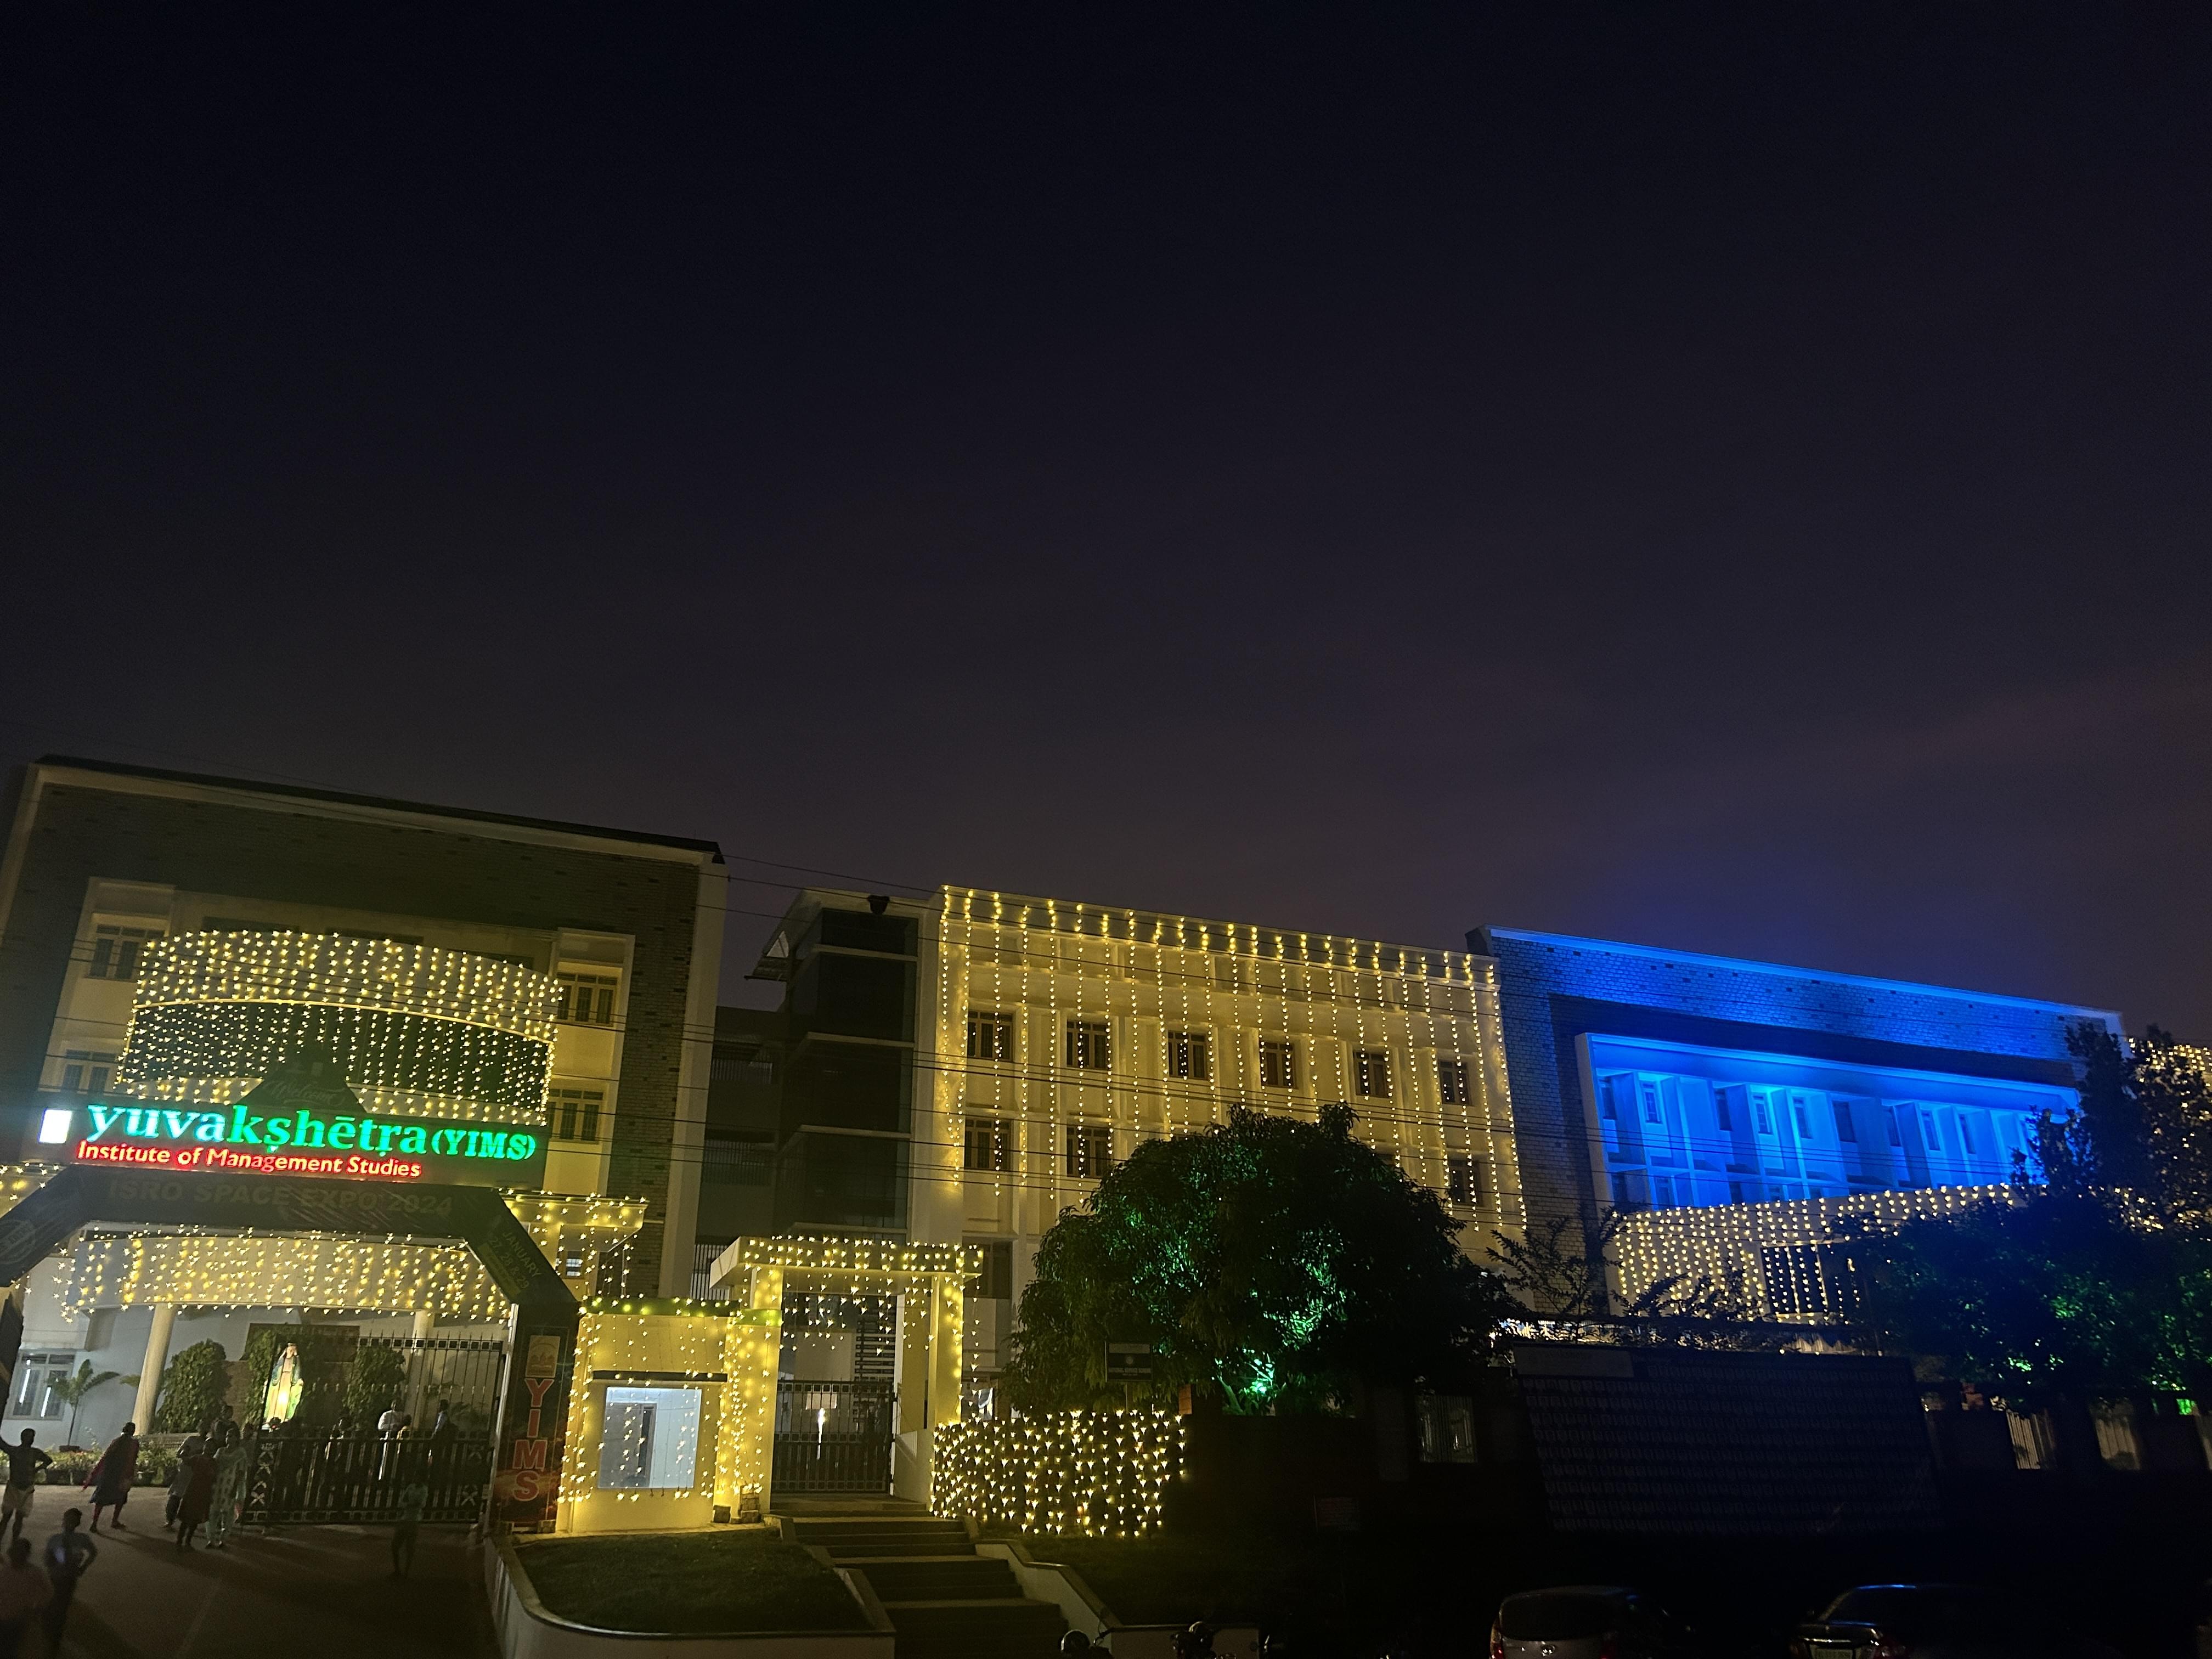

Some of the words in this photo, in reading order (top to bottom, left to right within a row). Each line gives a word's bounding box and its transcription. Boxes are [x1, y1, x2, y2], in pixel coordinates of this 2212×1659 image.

[77, 1140, 171, 1164] Institute
[177, 1147, 204, 1165] of
[206, 1148, 343, 1173] Management
[347, 1155, 421, 1177] Studies
[109, 1179, 183, 1201] ISRO
[194, 1183, 289, 1206] SPACE
[300, 1187, 378, 1209] EXPO
[386, 1193, 453, 1215] 2024
[500, 1252, 514, 1266] 28
[516, 1275, 530, 1289] 29
[502, 1232, 542, 1278] JANUARY
[511, 1378, 555, 1502] YIMS
